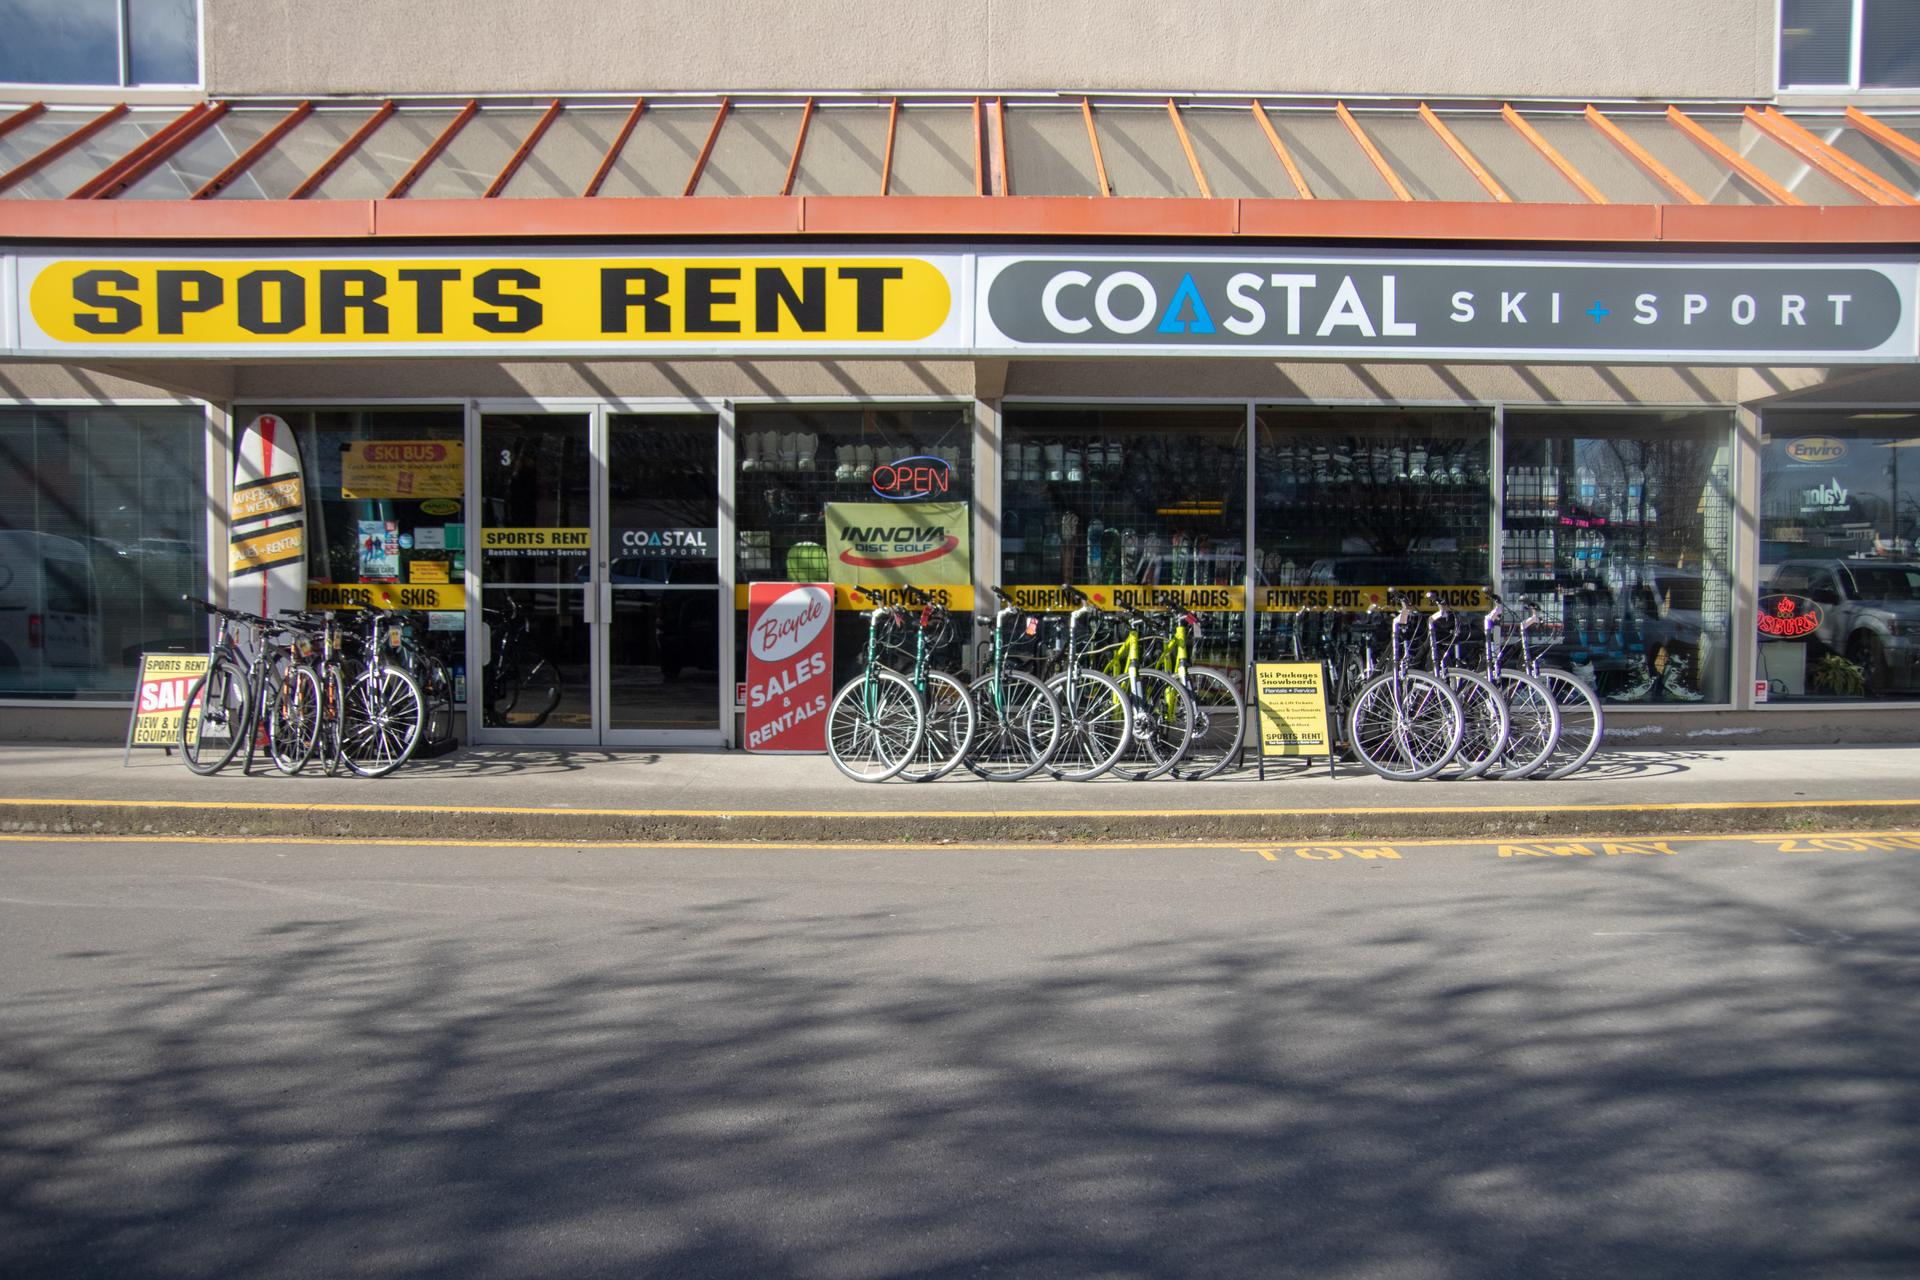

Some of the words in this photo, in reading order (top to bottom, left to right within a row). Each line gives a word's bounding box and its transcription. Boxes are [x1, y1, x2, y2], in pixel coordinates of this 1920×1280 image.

[72, 268, 543, 335] SPORTS
[600, 266, 903, 333] RENT
[1042, 270, 1417, 338] COASTAL
[1450, 291, 1560, 325] SKI
[1633, 293, 1852, 326] SPORT
[375, 446, 399, 460] SKI
[404, 446, 434, 460] BUS
[1794, 440, 1842, 456] Enviro
[501, 450, 511, 466] 3
[872, 466, 949, 492] OPEN
[486, 532, 545, 545] SPORTS
[551, 532, 588, 545] RENT
[622, 531, 707, 547] COASTAL
[840, 526, 945, 542] INNOVA
[622, 548, 647, 556] SKI
[660, 548, 707, 556] SPORT
[855, 543, 889, 552] DISC
[894, 543, 934, 552] GOLF
[401, 588, 436, 605] SKIS
[1016, 589, 1081, 606] SURFING
[1266, 590, 1327, 607] FITNESS
[1386, 589, 1425, 607] ROF
[757, 598, 824, 652] Bicycle
[147, 660, 182, 670] SPORTS
[184, 661, 206, 671] RENT
[750, 652, 826, 707] SALES
[1276, 671, 1318, 679] Packages
[783, 696, 791, 707] &
[137, 717, 159, 729] NEW
[162, 717, 169, 729] &
[173, 717, 198, 729] UED
[749, 695, 826, 748] RENTALS
[137, 730, 194, 742] EQUIPMET
[1240, 846, 1403, 861] TOW
[1497, 842, 1680, 858] AWAY
